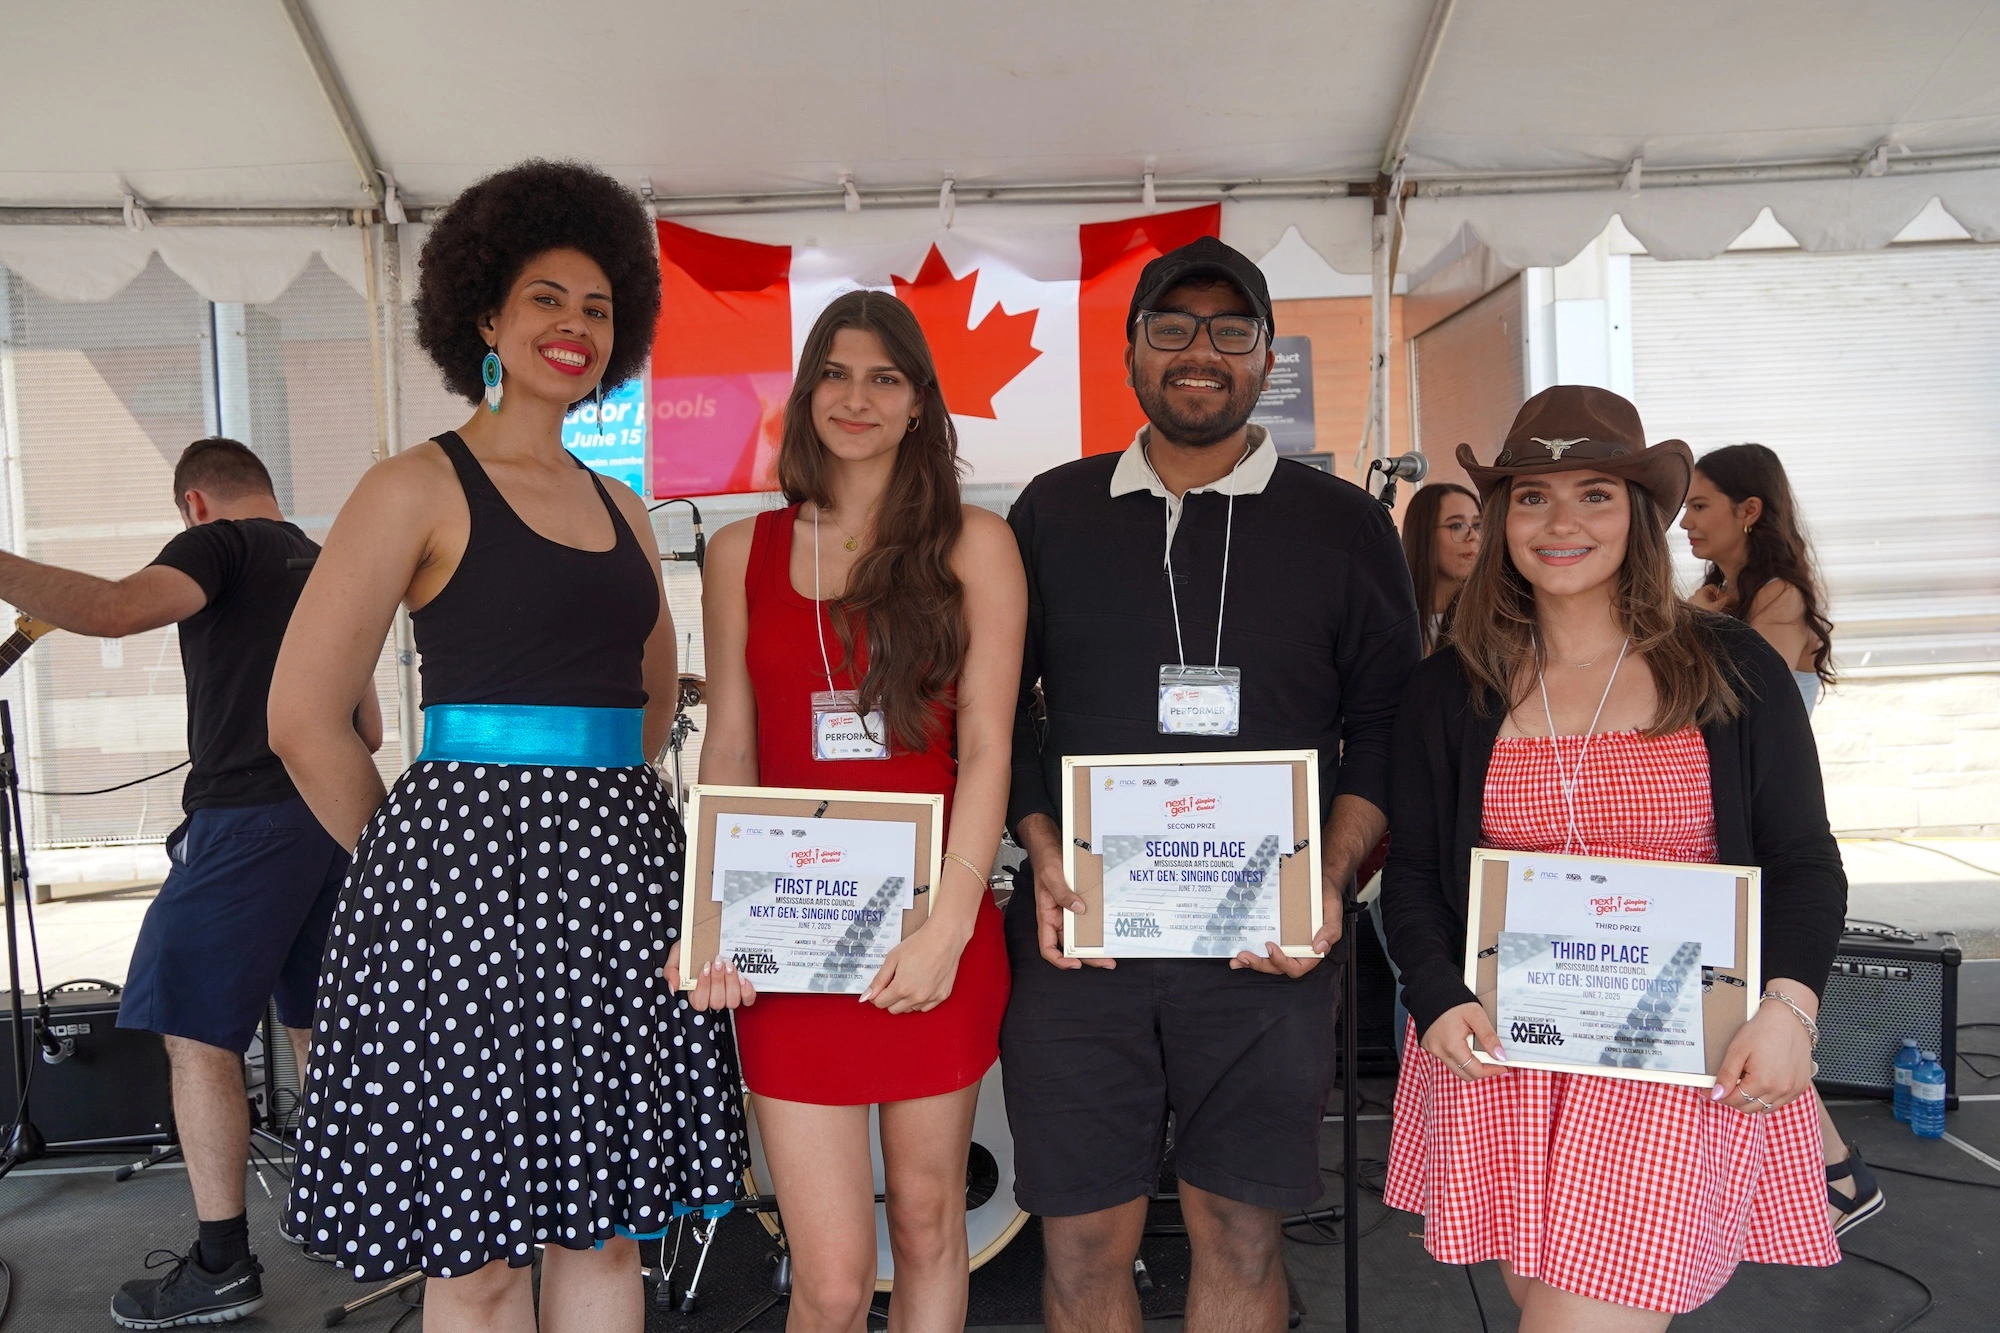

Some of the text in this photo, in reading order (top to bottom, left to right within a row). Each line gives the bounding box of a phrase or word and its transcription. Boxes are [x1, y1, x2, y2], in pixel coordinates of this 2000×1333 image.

[567, 428, 643, 448] June 15
[1170, 706, 1225, 715] PERFORMER
[826, 732, 878, 741] PERFORMER
[1166, 798, 1186, 808] next
[1171, 806, 1190, 817] gen
[791, 848, 812, 859] next
[1146, 841, 1246, 858] SECOND PLACE
[796, 857, 815, 868] gen
[1210, 860, 1234, 868] COUNCIL
[1130, 870, 1264, 883] NEXT GEN: SINGING CONTEST
[774, 878, 858, 897] FIRST PLACE
[775, 896, 814, 906] MISSISSAUGA
[831, 899, 856, 907] COUNCIL
[1590, 896, 1614, 906] next
[750, 906, 884, 922] NEXT GEN: SINGING CONTEST
[1596, 904, 1618, 916] gen
[1114, 918, 1160, 928] METAL
[1595, 922, 1642, 932] THIRD PRIZE
[1114, 928, 1162, 938] WORKS
[1550, 941, 1650, 964] THIRD PLACE
[732, 953, 776, 964] METAL
[1556, 962, 1646, 976] MISSISSAUGA ARTS COUNCIL
[1527, 972, 1682, 994] NEXT GEN: SINGING CONTEST
[1582, 991, 1621, 1000] JUNE 7, 2025
[1510, 1022, 1561, 1035] METAL
[1511, 1032, 1565, 1046] WORKS
